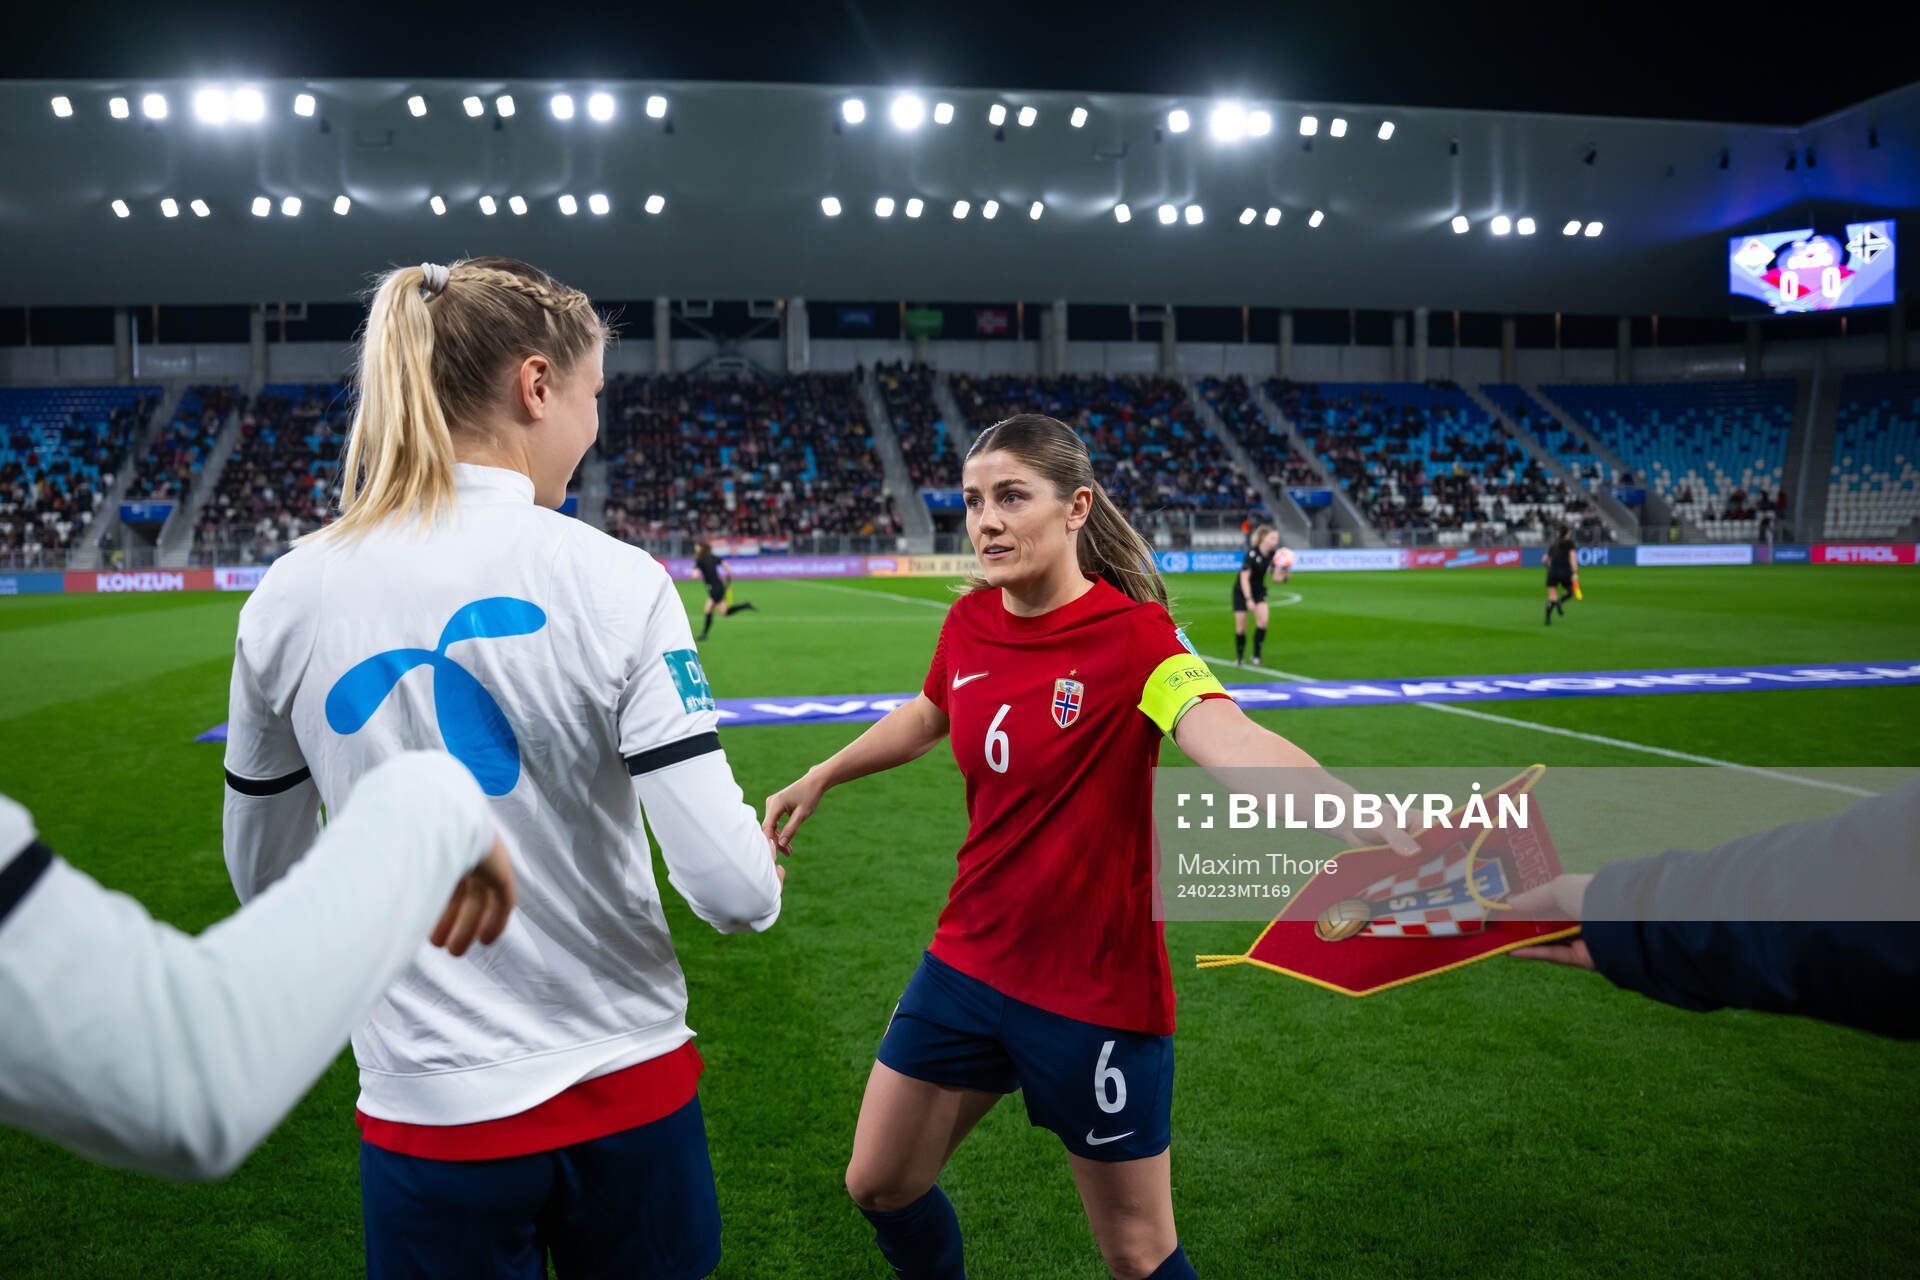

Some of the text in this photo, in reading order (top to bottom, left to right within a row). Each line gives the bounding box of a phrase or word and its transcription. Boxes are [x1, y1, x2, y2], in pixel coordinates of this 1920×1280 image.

[1780, 266, 1841, 302] 0 0
[1825, 546, 1898, 562] PETROL
[97, 572, 184, 593] KONZUM
[984, 703, 1012, 774] 6
[1094, 1040, 1127, 1114] 6
